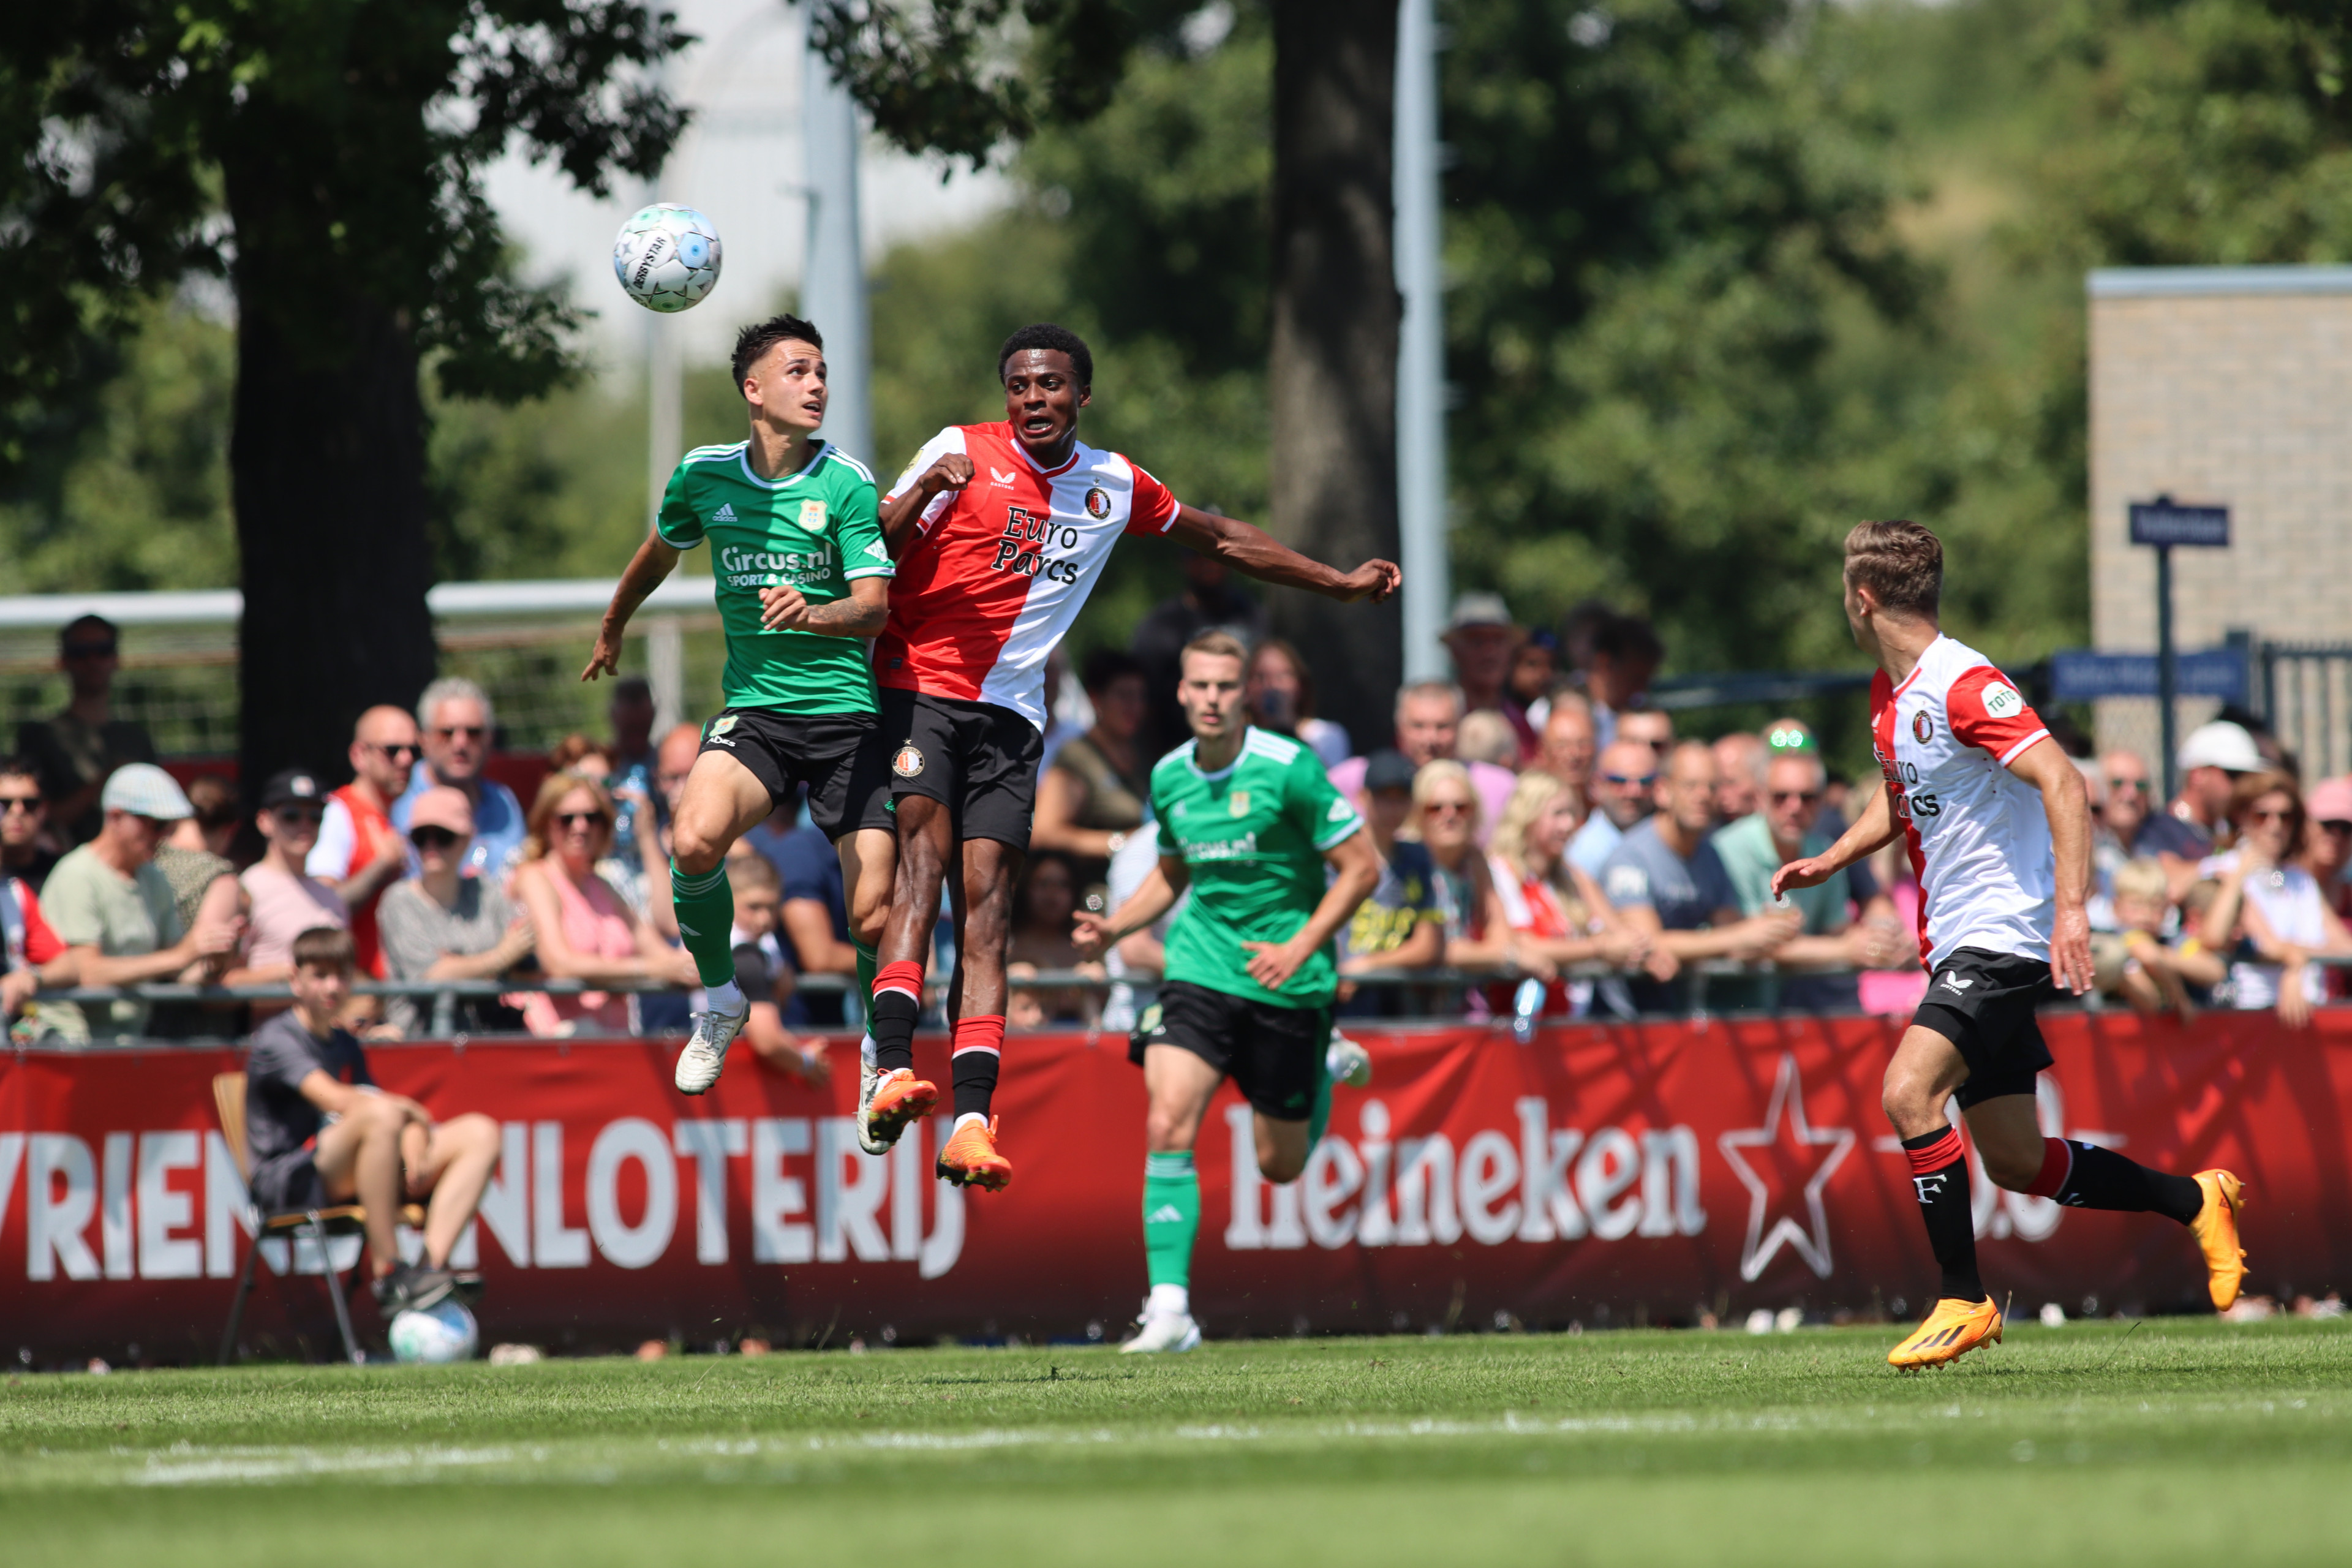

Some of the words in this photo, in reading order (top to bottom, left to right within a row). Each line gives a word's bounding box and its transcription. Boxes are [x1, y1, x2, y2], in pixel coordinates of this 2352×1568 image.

[633, 236, 667, 290] DERBYSTAR
[990, 481, 1014, 491] CASTORE
[1003, 505, 1078, 549] Euro
[721, 542, 832, 571] Circus.nl
[990, 539, 1079, 586] Parcs
[727, 573, 764, 587] SPORT
[766, 573, 778, 585] &
[781, 567, 831, 585] CASINO
[1988, 690, 2016, 712] TOTO
[1225, 1096, 1708, 1251] Heineken
[1912, 1173, 1948, 1204] F
